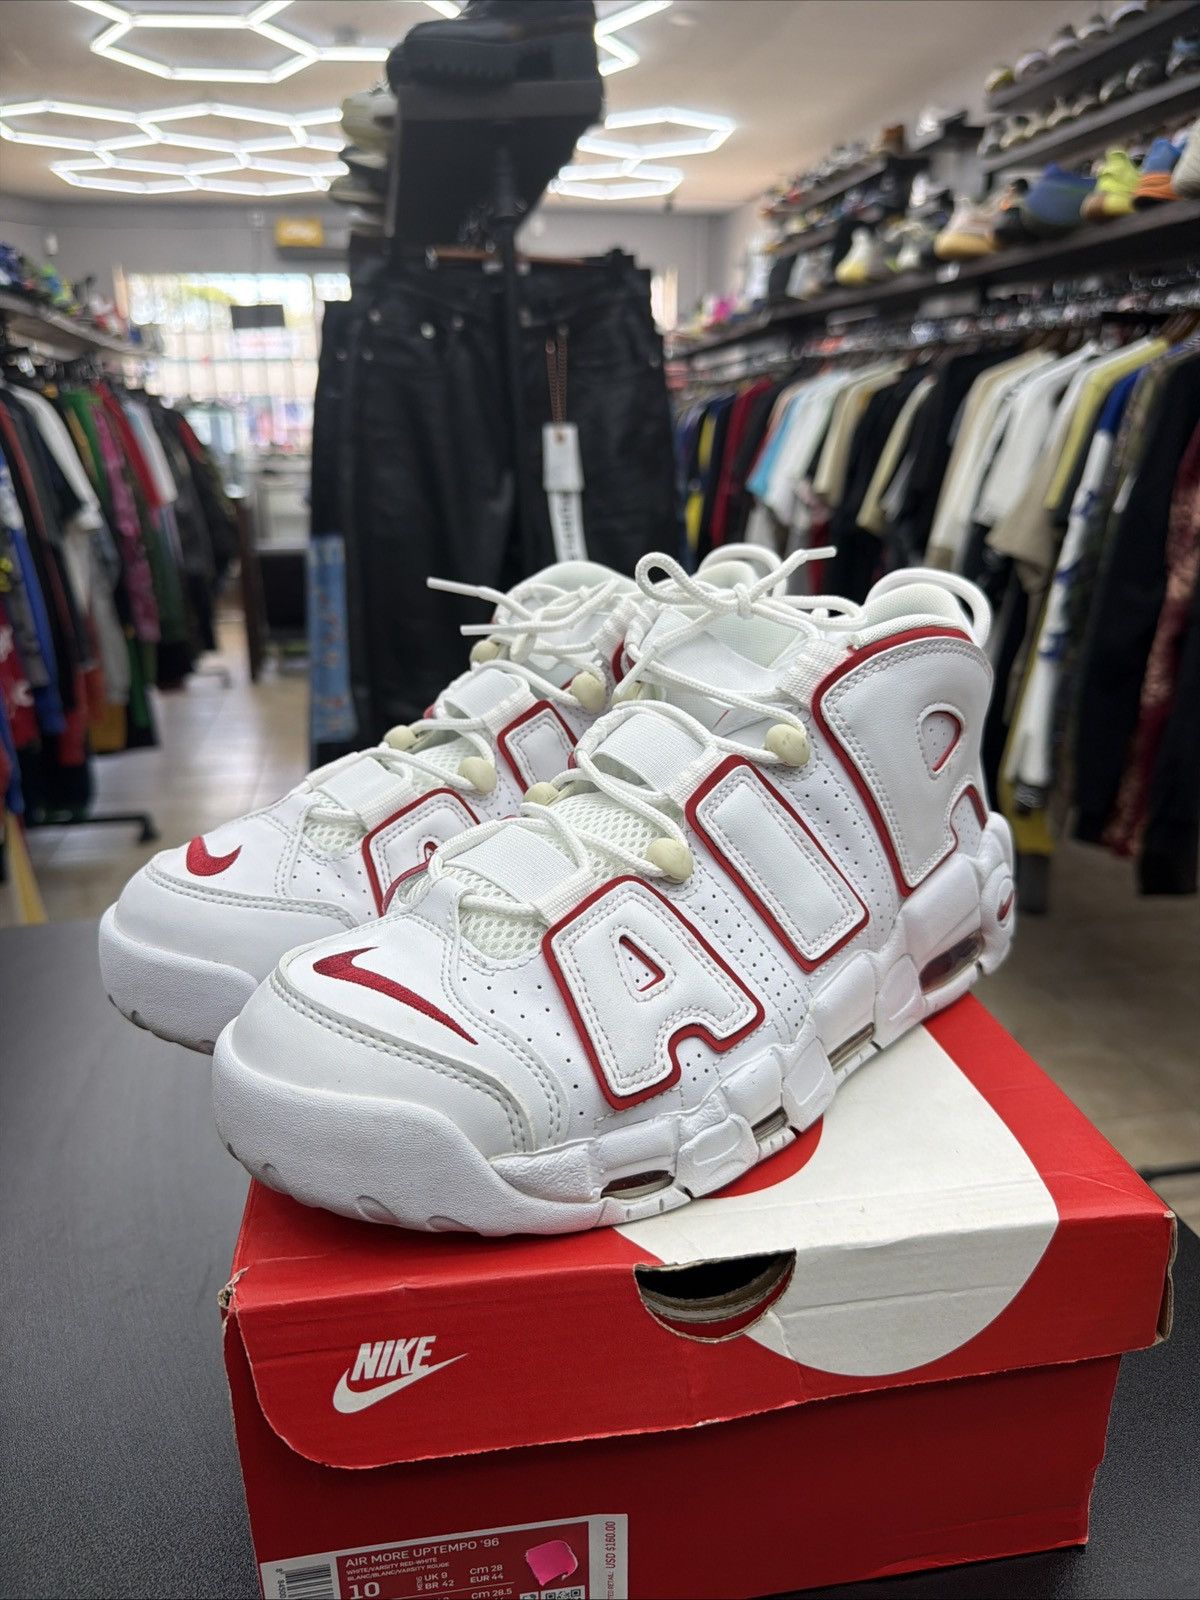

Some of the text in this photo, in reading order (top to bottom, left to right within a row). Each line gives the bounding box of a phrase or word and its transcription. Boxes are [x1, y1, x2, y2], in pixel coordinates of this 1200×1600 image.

[542, 626, 990, 1110] AIR
[350, 1335, 437, 1380] NIKE
[605, 1521, 616, 1552] $160.00
[345, 1556, 368, 1568] AIR
[371, 1550, 410, 1564] MORE
[413, 1541, 477, 1557] UPTEMPO
[605, 1553, 616, 1569] USD
[424, 1571, 448, 1581] UK 9
[491, 1564, 503, 1572] 28
[425, 1580, 455, 1590] BR 42
[470, 1575, 490, 1583] EUR
[348, 1581, 380, 1600] 10
[492, 1588, 513, 1597] 28.5
